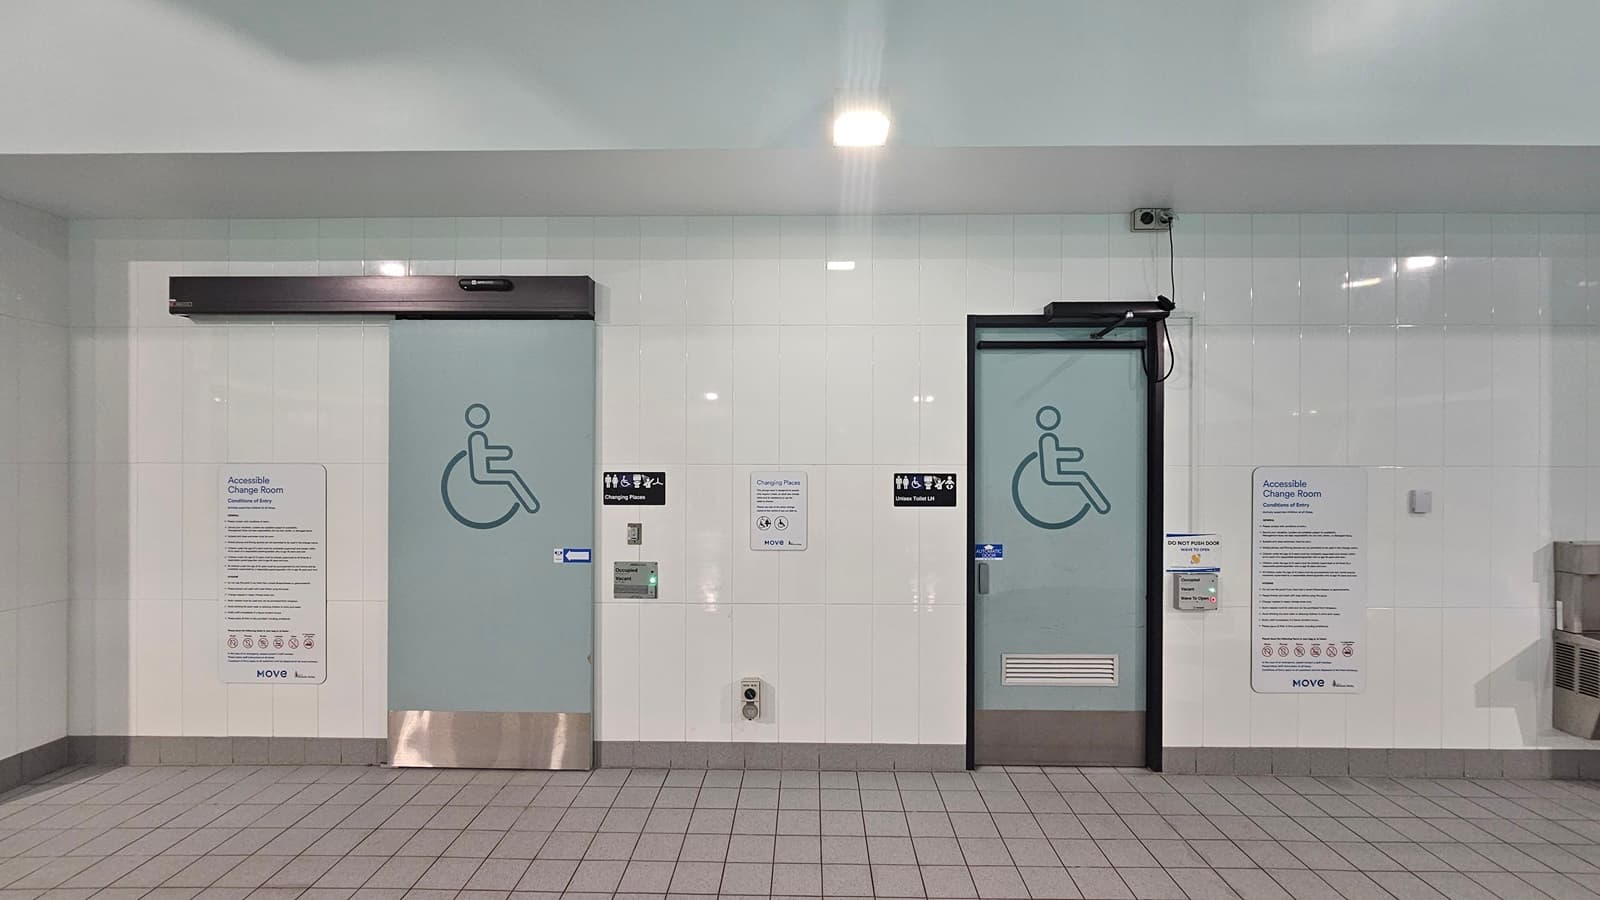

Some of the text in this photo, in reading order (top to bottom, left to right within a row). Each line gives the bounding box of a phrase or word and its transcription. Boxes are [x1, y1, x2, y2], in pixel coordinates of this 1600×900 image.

[228, 476, 270, 484] Accessible
[1263, 480, 1307, 488] Accessible
[228, 486, 284, 495] Change Room
[1263, 490, 1322, 499] Change Room
